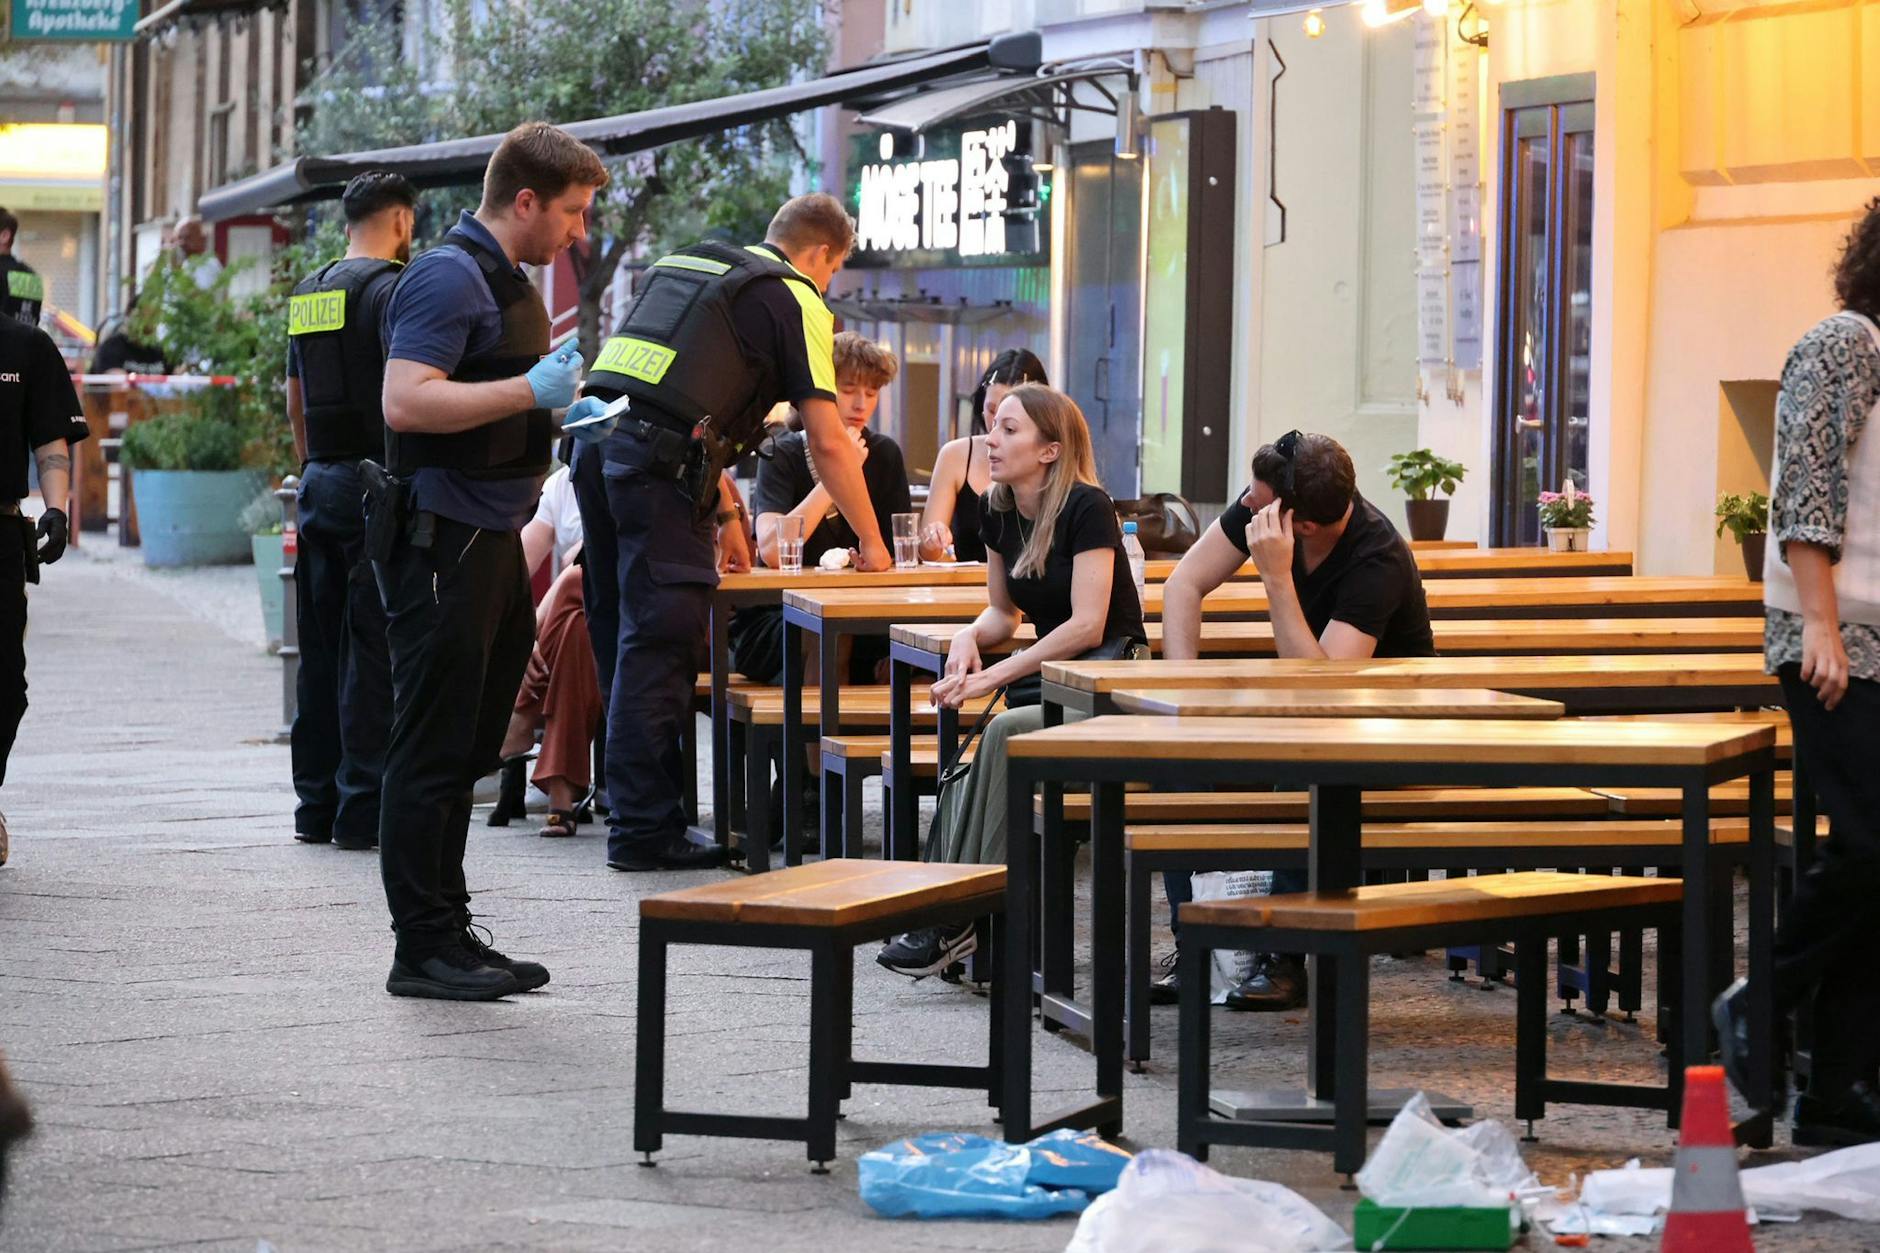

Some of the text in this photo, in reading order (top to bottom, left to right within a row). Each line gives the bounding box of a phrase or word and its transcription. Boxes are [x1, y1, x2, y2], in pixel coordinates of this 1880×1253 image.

[28, 11, 120, 34] Apotheke
[291, 297, 341, 329] POLIZEI
[0, 372, 20, 382] ant
